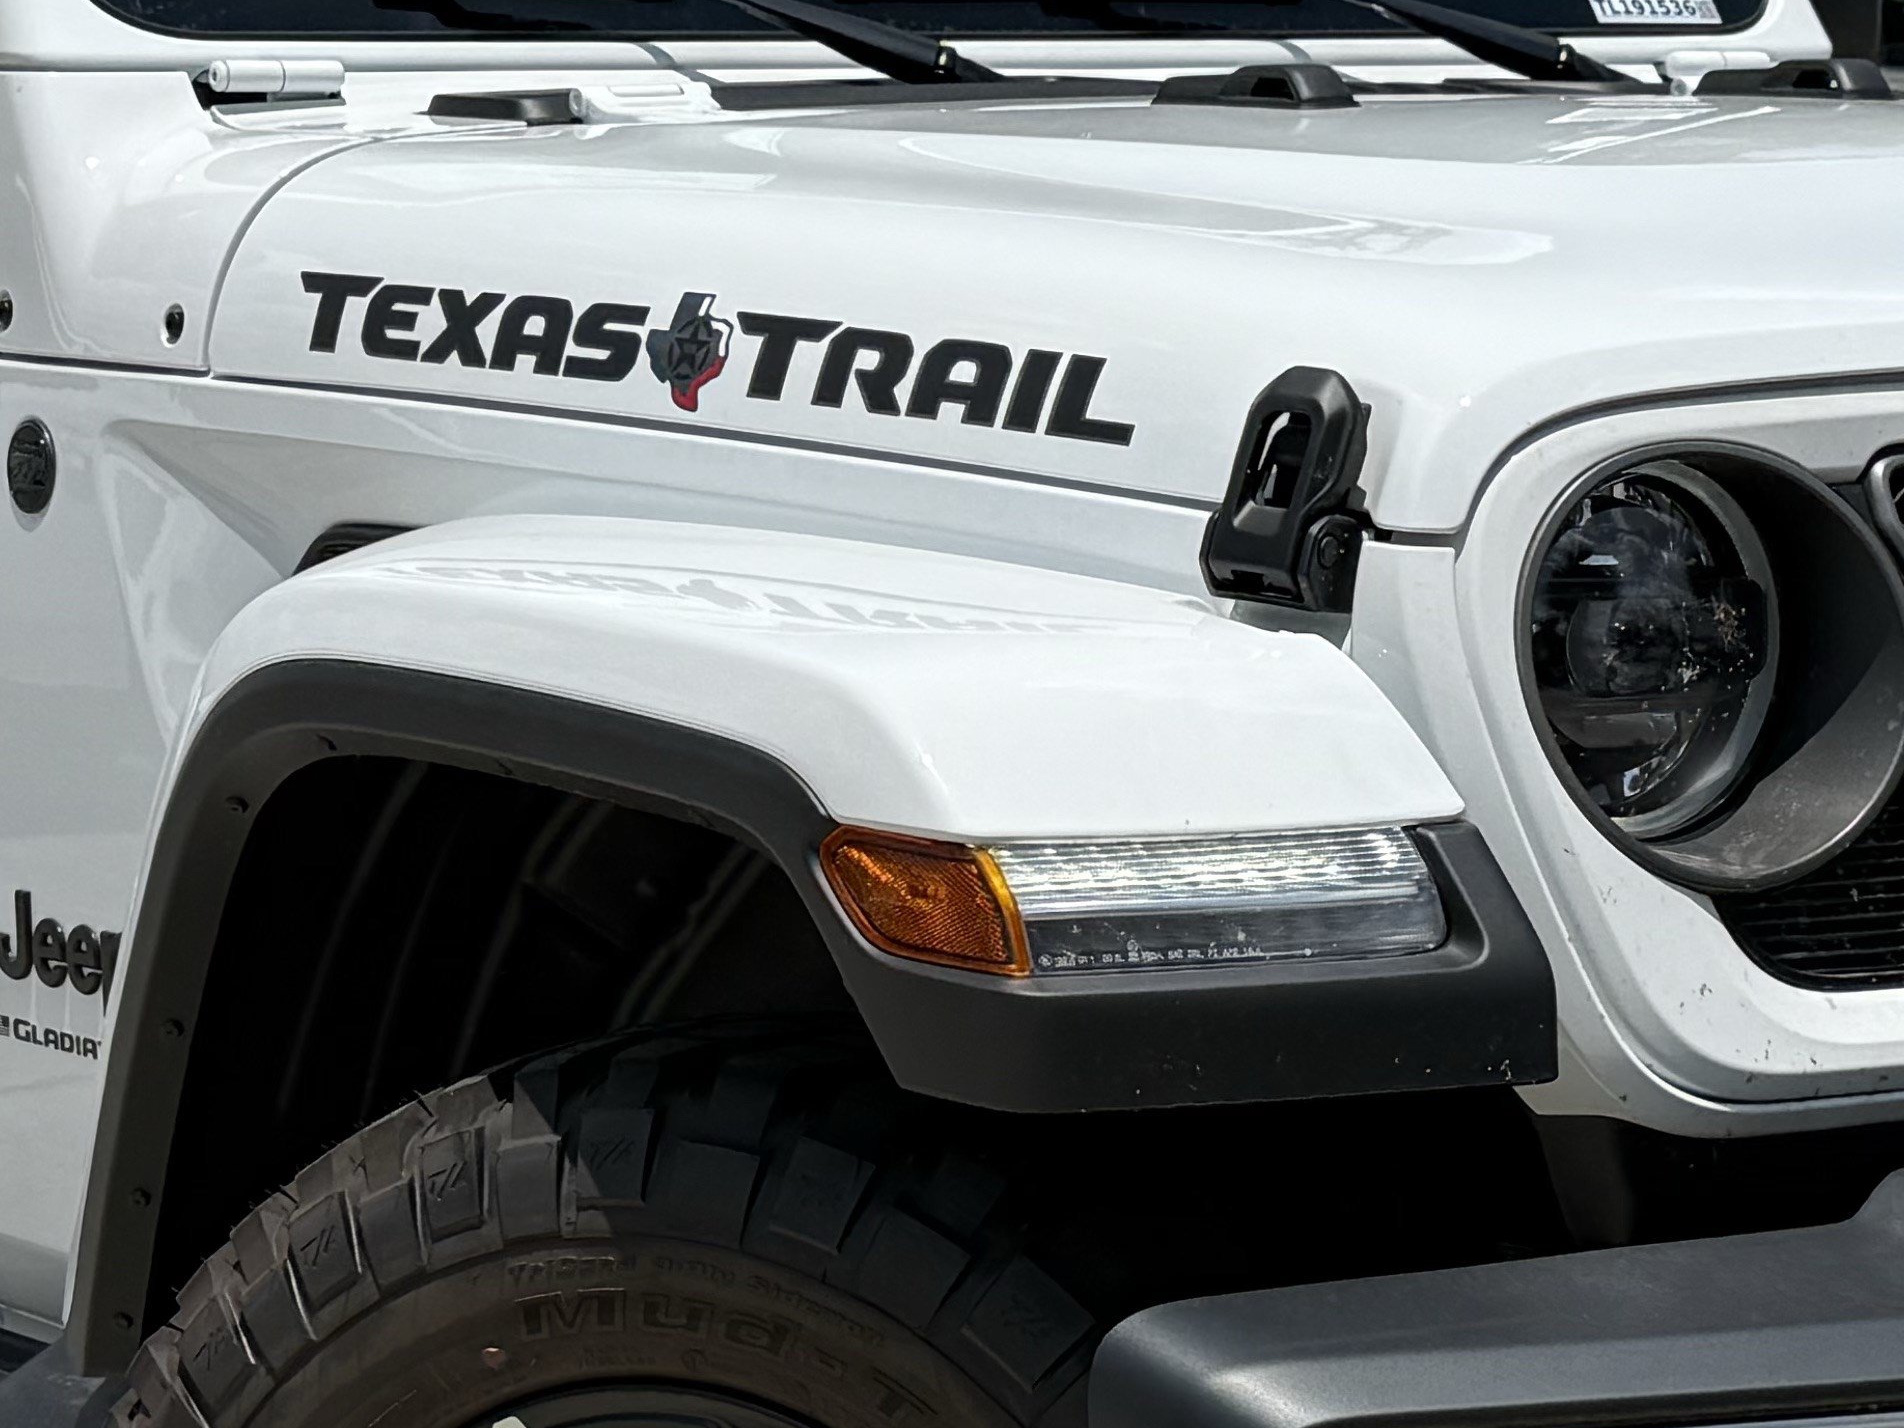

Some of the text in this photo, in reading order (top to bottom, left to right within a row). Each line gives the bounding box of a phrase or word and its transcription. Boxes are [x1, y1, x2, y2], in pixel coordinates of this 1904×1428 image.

[300, 271, 1136, 448] TEXAS TRAIL
[13, 1018, 102, 1060] GLADIA
